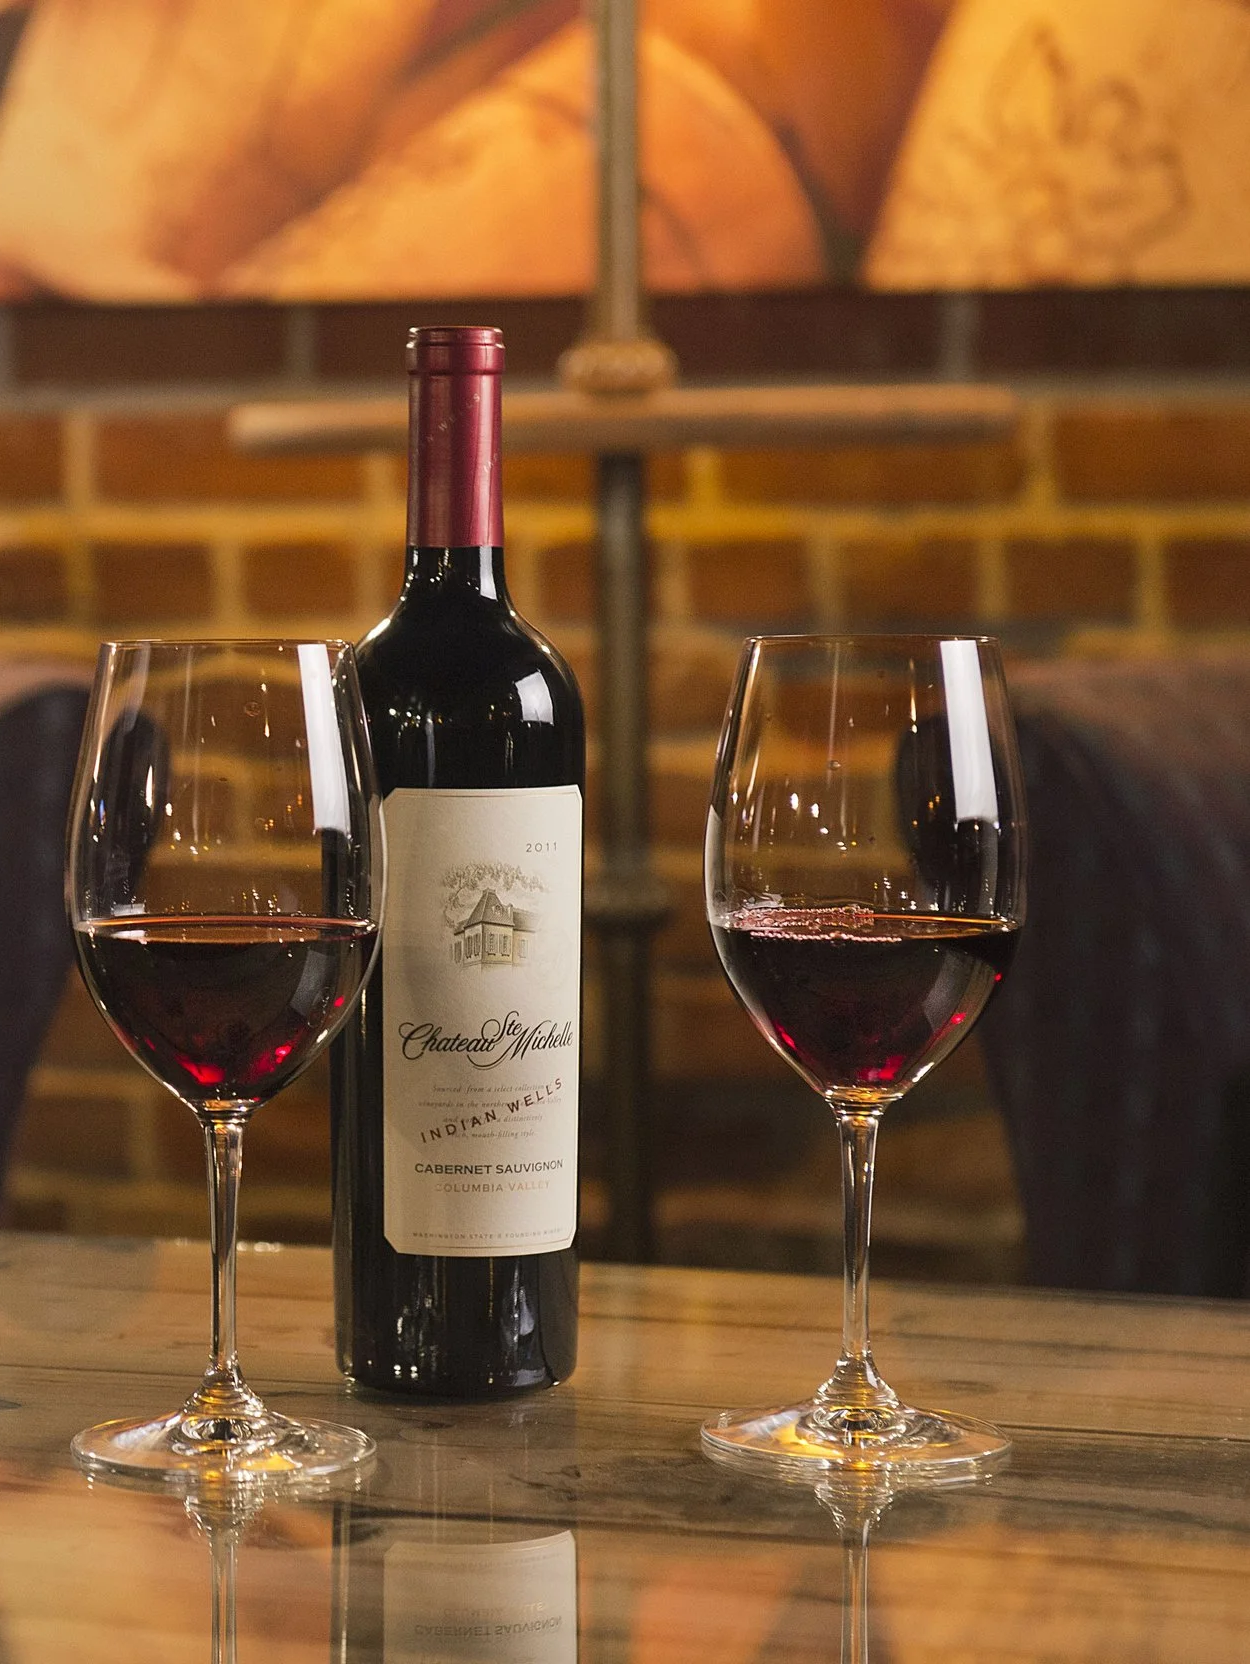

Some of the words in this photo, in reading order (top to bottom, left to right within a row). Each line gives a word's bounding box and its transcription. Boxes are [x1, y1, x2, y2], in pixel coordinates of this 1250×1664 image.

[526, 841, 556, 853] 2011
[398, 1021, 496, 1061] Chateau
[484, 1010, 523, 1041] Ste
[491, 1019, 574, 1064] Michelle
[421, 1109, 497, 1144] INDIAN
[507, 1078, 562, 1114] WELLS
[414, 1162, 493, 1175] CABERNET
[495, 1159, 564, 1174] SAUVIGNON
[434, 1183, 504, 1193] COLUMBIA
[508, 1180, 550, 1192] VALLEY
